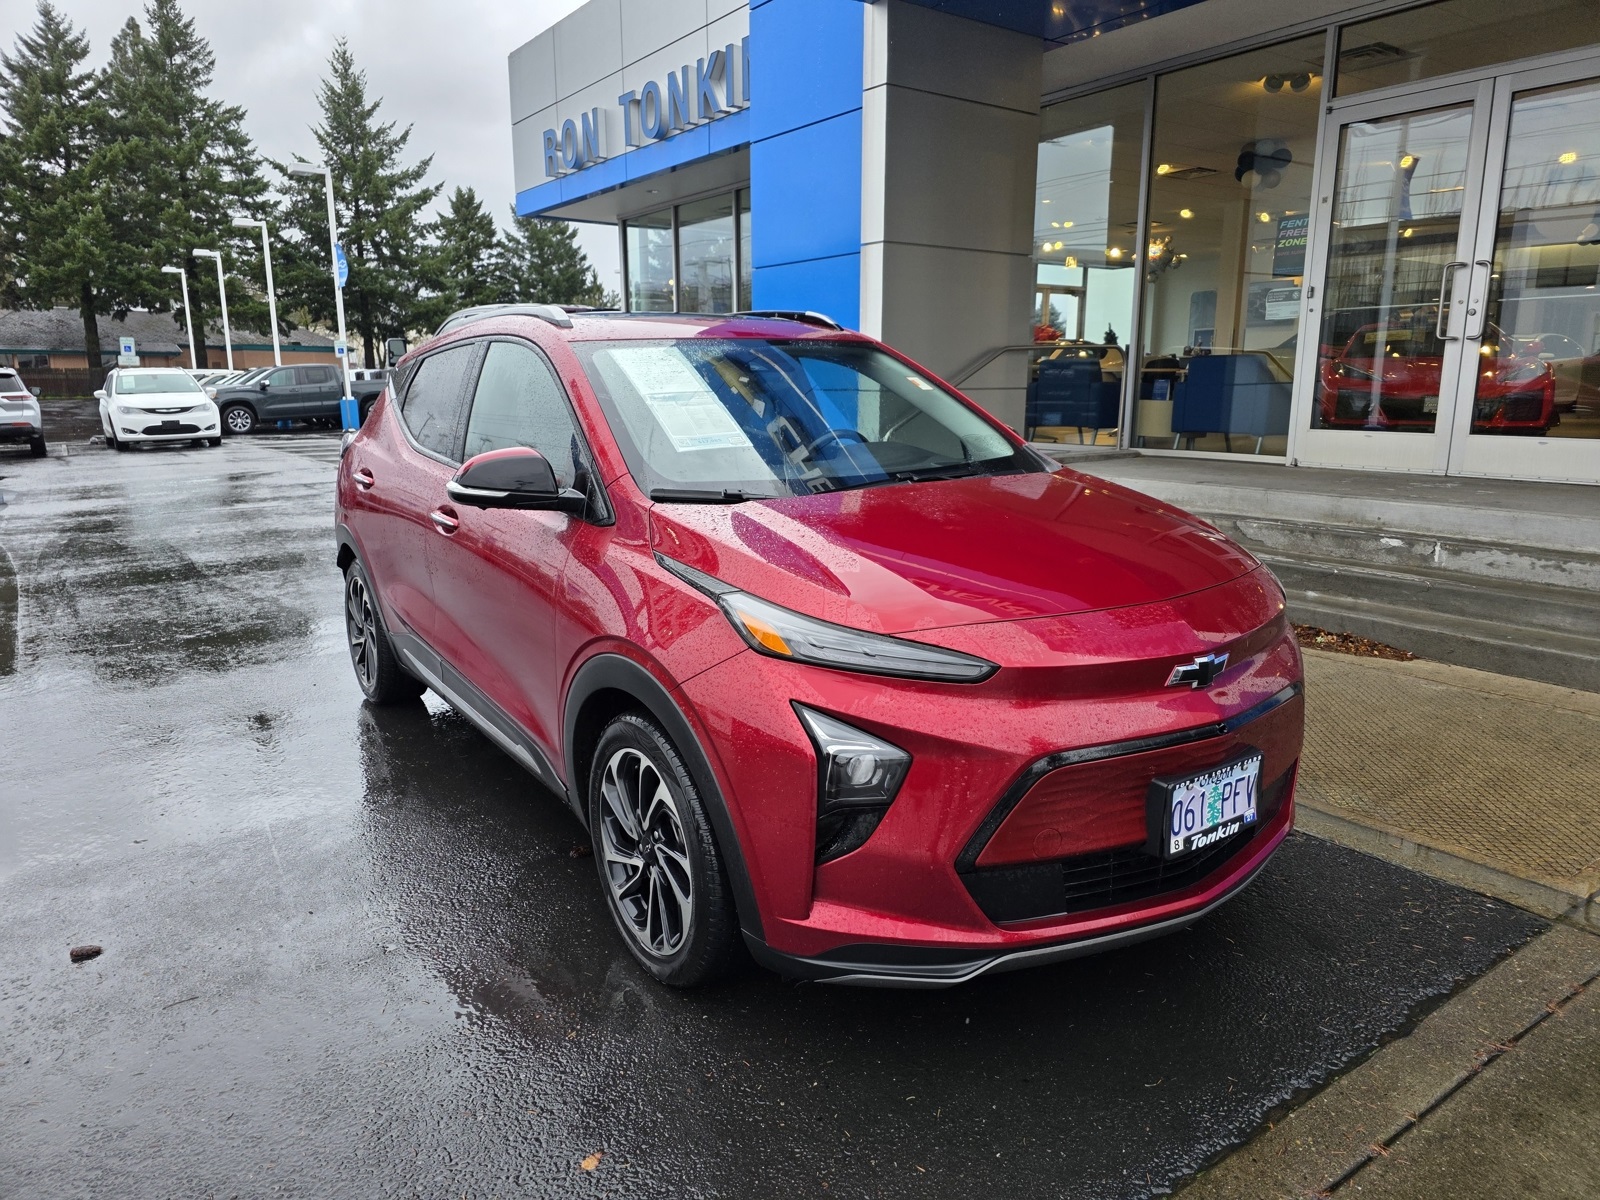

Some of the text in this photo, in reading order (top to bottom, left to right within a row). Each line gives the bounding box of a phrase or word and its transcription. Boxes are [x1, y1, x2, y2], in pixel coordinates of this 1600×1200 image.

[543, 107, 606, 178] RON
[1279, 228, 1308, 238] FREE
[1280, 218, 1309, 229] FENT
[1278, 237, 1307, 247] ZONE
[1175, 780, 1191, 790] FOR
[1194, 773, 1209, 782] THE
[1212, 766, 1231, 777] LOVE
[1244, 755, 1262, 764] CARS
[1170, 773, 1257, 836] 061 PFV
[1190, 822, 1240, 851] Tonkin
